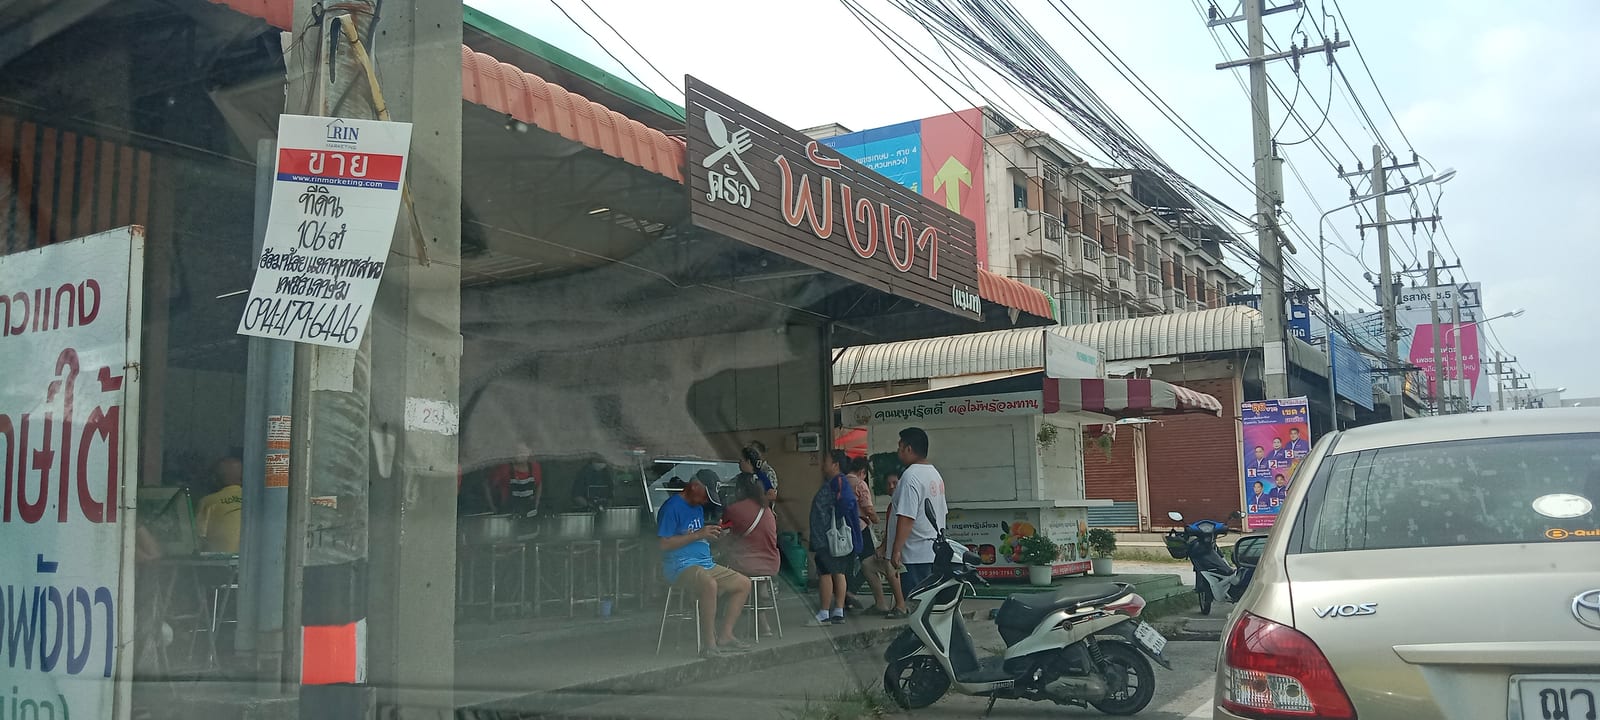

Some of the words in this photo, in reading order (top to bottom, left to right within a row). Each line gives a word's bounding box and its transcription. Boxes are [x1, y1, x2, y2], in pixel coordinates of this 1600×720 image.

[334, 126, 359, 140] RIN
[308, 151, 369, 178] ขาย
[292, 174, 383, 188] www.rinmarketing.com
[706, 163, 752, 209] ครัว
[773, 141, 939, 281] พังงา
[297, 220, 327, 251] 106
[1299, 407, 1306, 415] 4
[1250, 505, 1257, 513] 4
[1271, 498, 1278, 506] 5
[0, 553, 114, 678] พังงา
[1312, 603, 1377, 618] VIOS
